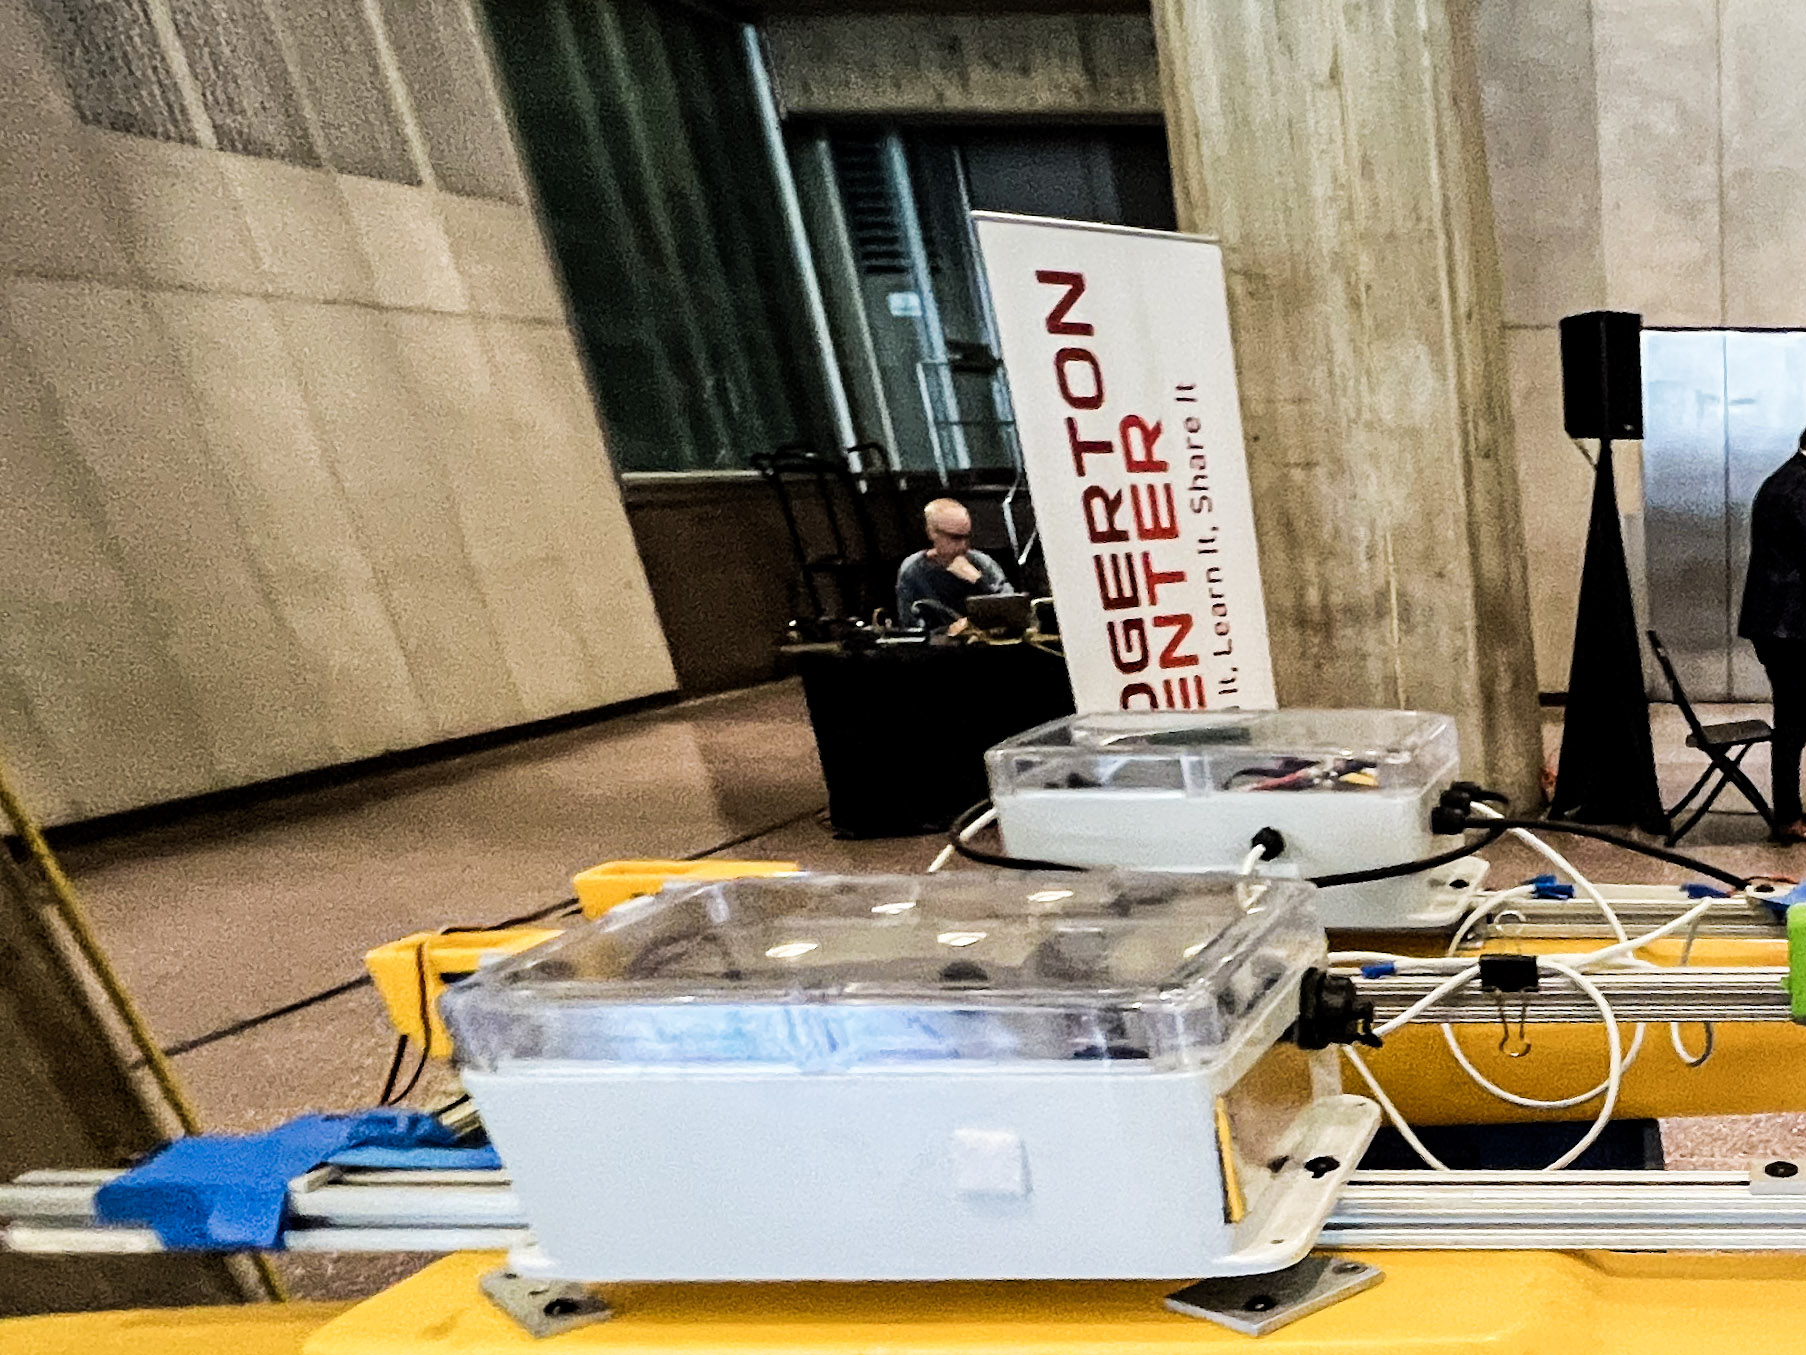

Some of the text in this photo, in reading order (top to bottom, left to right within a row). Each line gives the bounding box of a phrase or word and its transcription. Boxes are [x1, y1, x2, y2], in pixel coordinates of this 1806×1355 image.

[1174, 382, 1198, 402] It
[1183, 416, 1213, 514] Share
[1206, 566, 1233, 656] Learn
